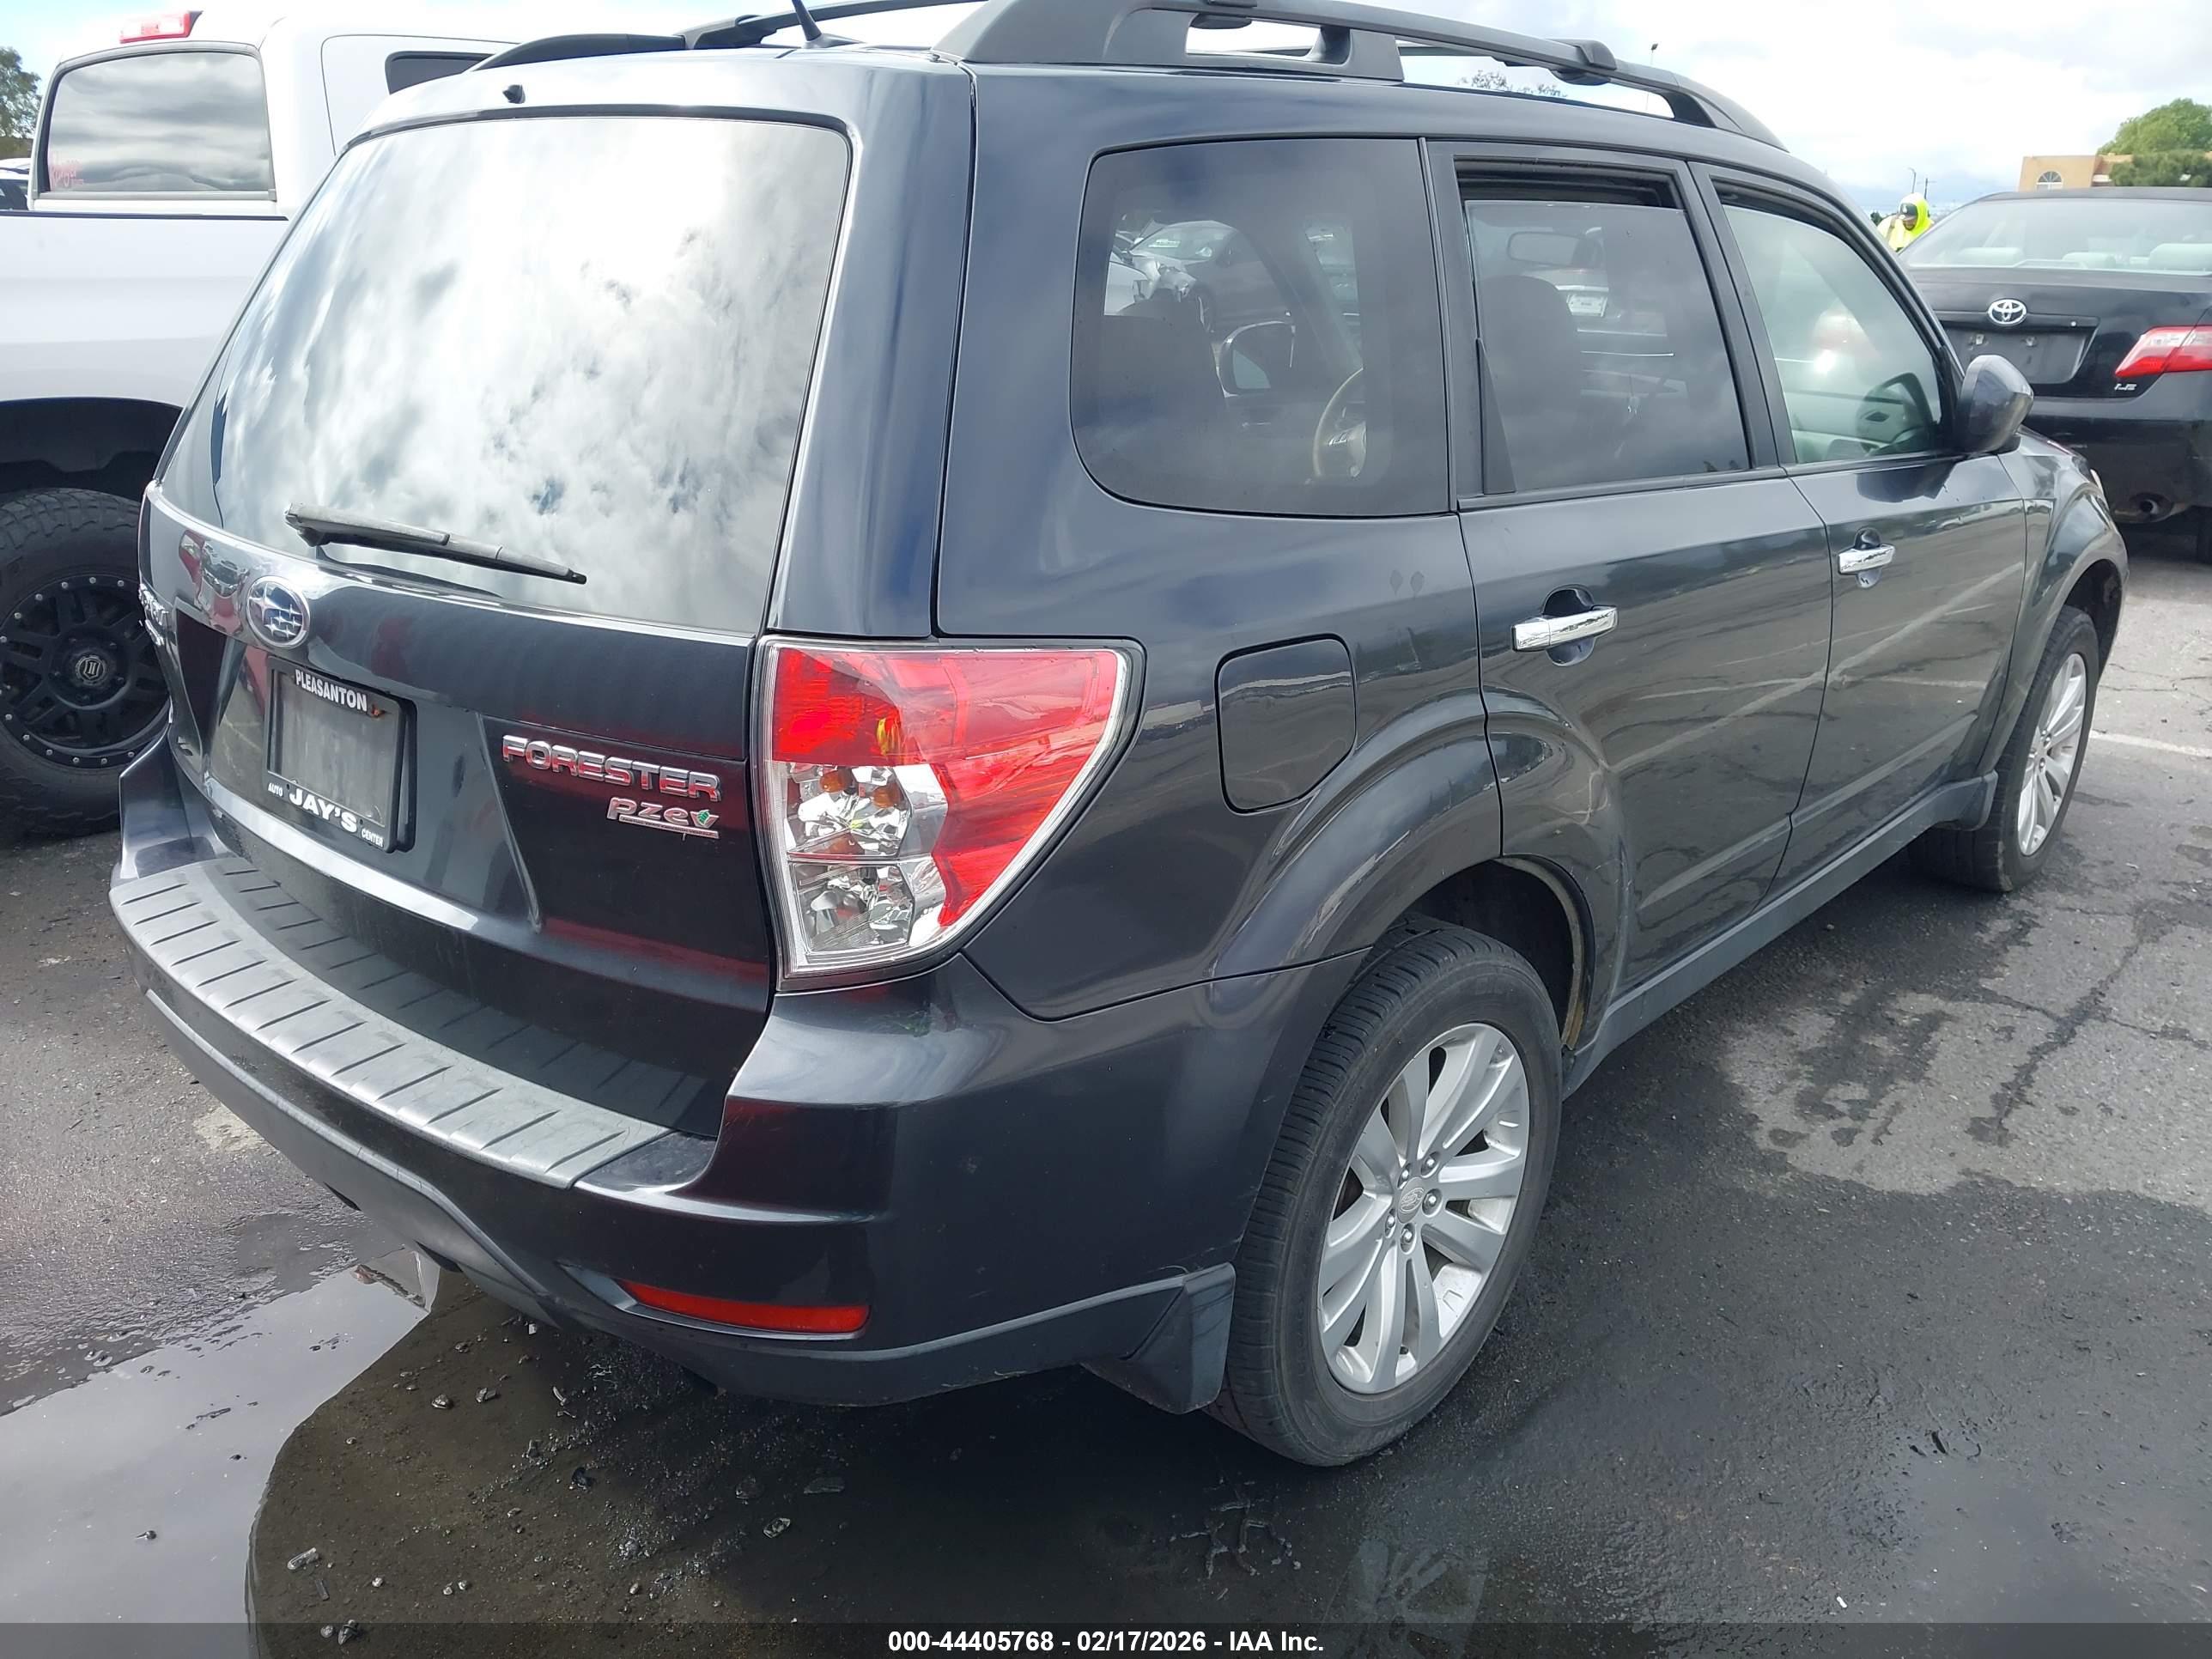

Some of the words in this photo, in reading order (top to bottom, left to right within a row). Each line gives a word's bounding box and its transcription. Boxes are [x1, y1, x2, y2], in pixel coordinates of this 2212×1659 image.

[295, 669, 368, 712] PLEASANTON
[502, 734, 722, 802] FORESTER
[268, 782, 283, 798] AUTO
[289, 788, 357, 833] JAY'S
[361, 827, 384, 848] CENTER
